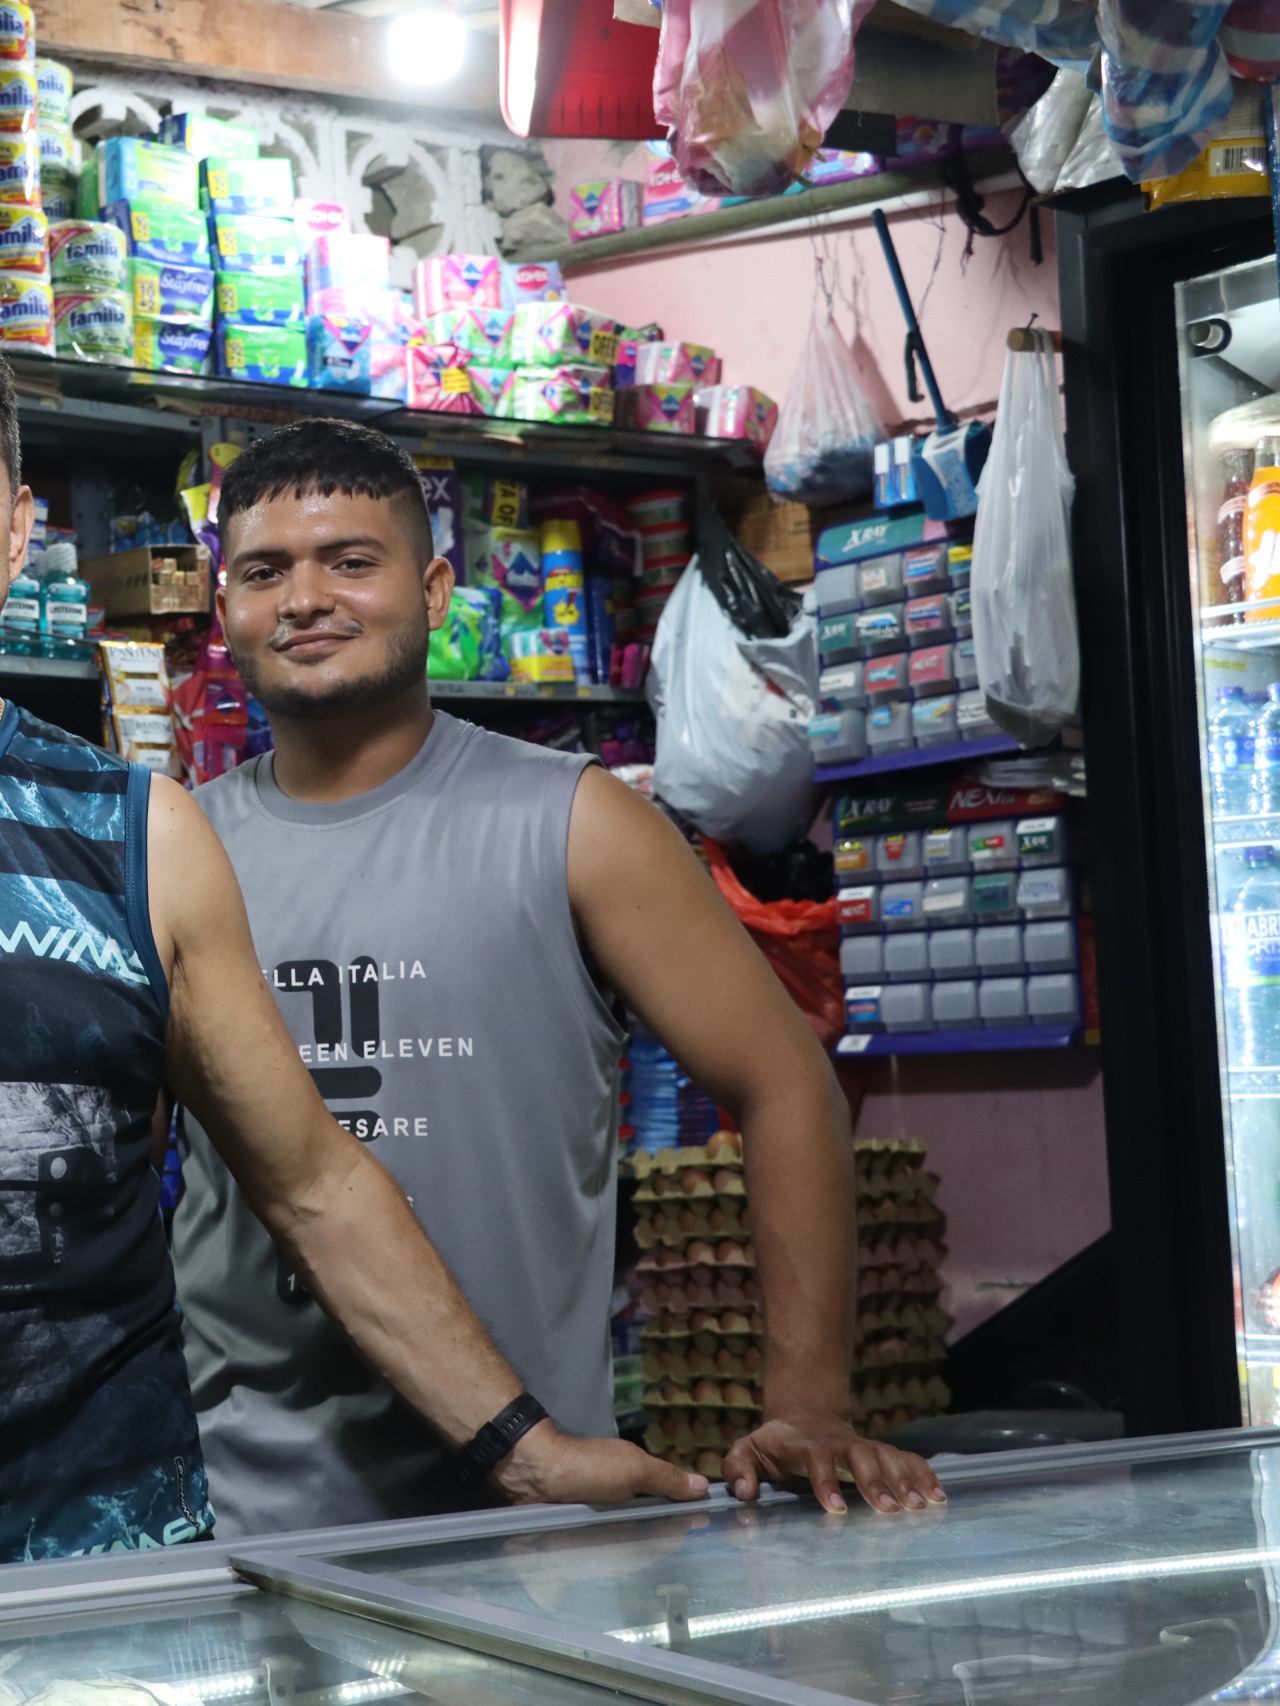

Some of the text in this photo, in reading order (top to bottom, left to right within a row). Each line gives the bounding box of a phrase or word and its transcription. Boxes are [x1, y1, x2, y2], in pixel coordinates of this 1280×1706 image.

[66, 240, 118, 260] familia
[160, 273, 210, 297] Stayfree
[69, 306, 126, 328] familia
[161, 331, 210, 352] Stayfree
[338, 960, 427, 984] ITALIA
[363, 1037, 474, 1060] ELEVEN
